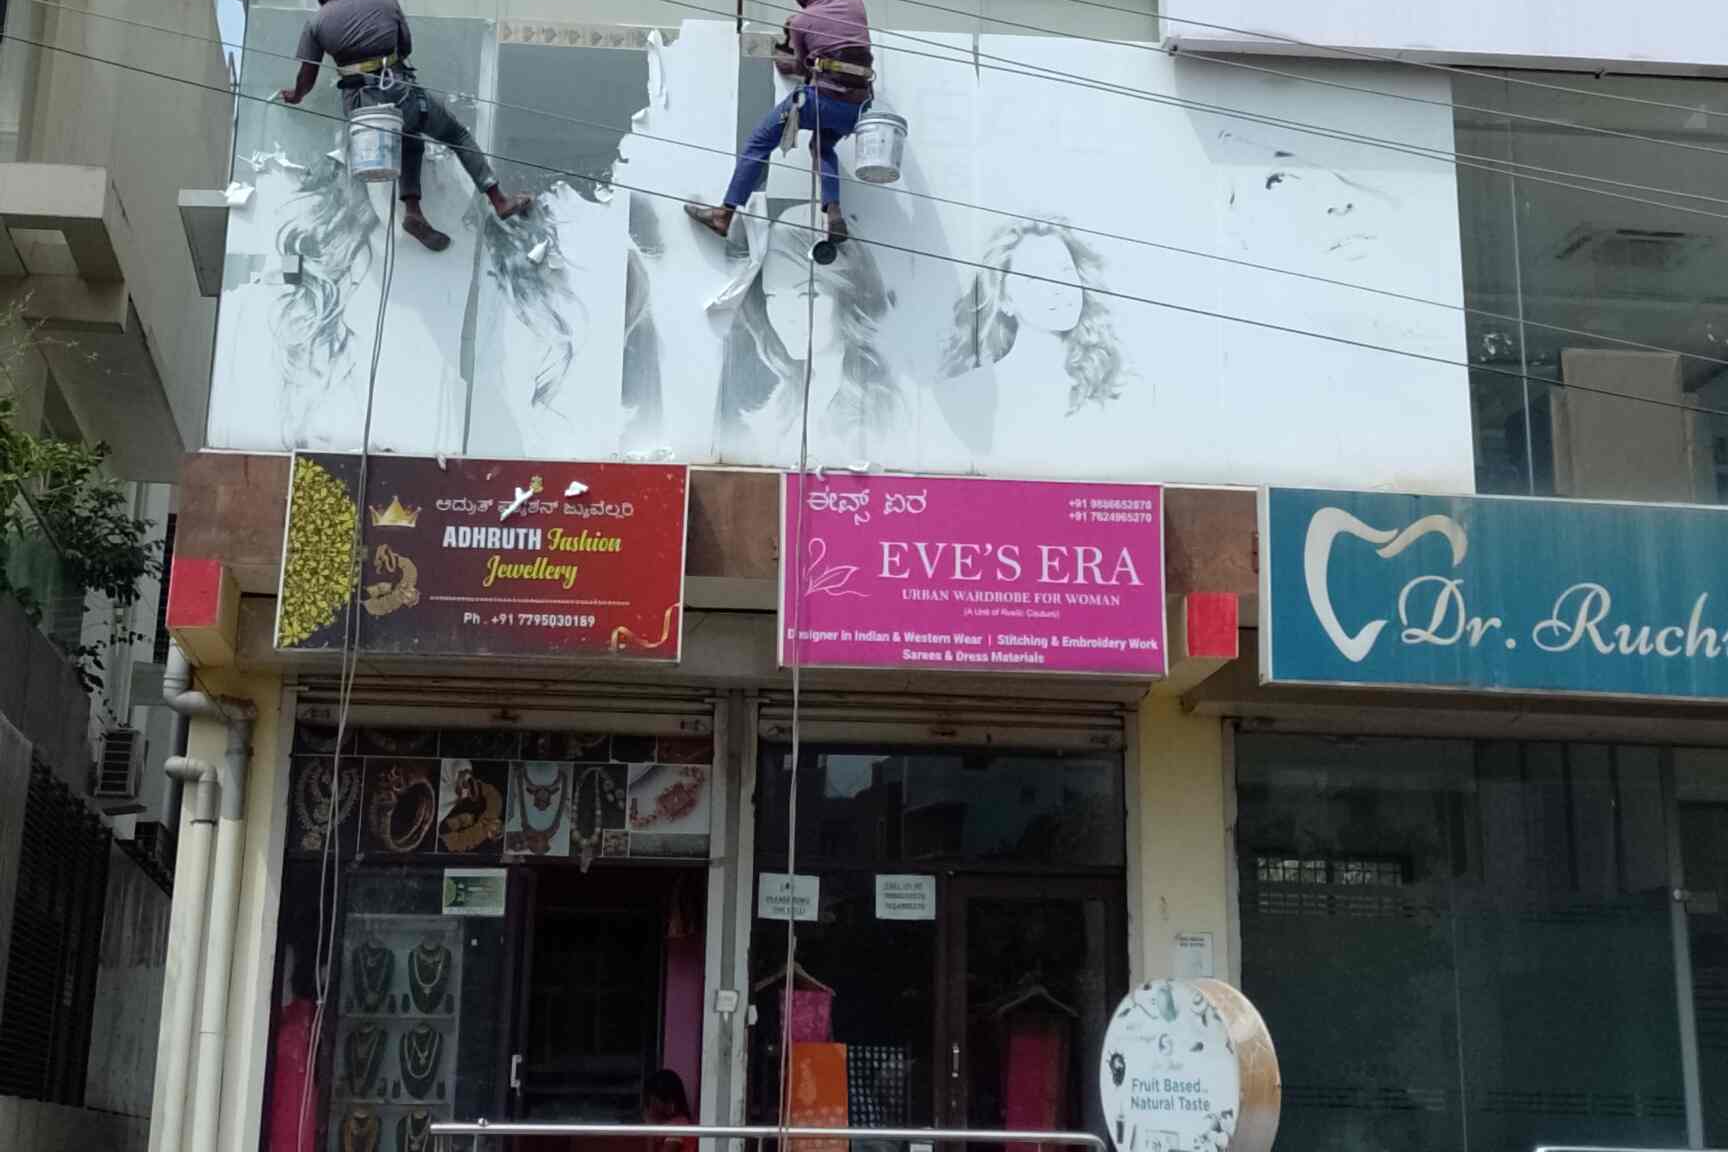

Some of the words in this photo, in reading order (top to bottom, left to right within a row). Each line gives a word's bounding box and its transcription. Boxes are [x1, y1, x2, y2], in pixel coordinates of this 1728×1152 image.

[546, 527, 622, 553] Fashion
[482, 554, 579, 590] Jewellery
[877, 540, 1022, 583] EVE'S
[1036, 544, 1145, 586] ERA
[901, 589, 950, 601] URBAN
[952, 590, 1032, 604] WARDROBE
[1033, 592, 1062, 605] FOR
[1065, 593, 1121, 606] WOMAN
[491, 613, 514, 626] +91
[1398, 575, 1517, 649] Dr.
[787, 628, 838, 643] Dsigner
[854, 630, 890, 642] Indian
[892, 631, 901, 642] &
[903, 631, 951, 644] Western
[953, 633, 983, 645] Wear
[997, 634, 1048, 649] Stitching
[1051, 635, 1060, 647] &
[1062, 636, 1127, 651] Embroidery
[1129, 638, 1159, 650] Work
[902, 649, 942, 661] Sarees
[944, 650, 953, 662] &
[956, 651, 989, 662] Dress
[991, 651, 1045, 663] Materials
[1131, 1077, 1160, 1093] Fruit
[1164, 1078, 1201, 1094] Based
[1130, 1095, 1174, 1111] Natural
[1178, 1096, 1211, 1112] Taste
